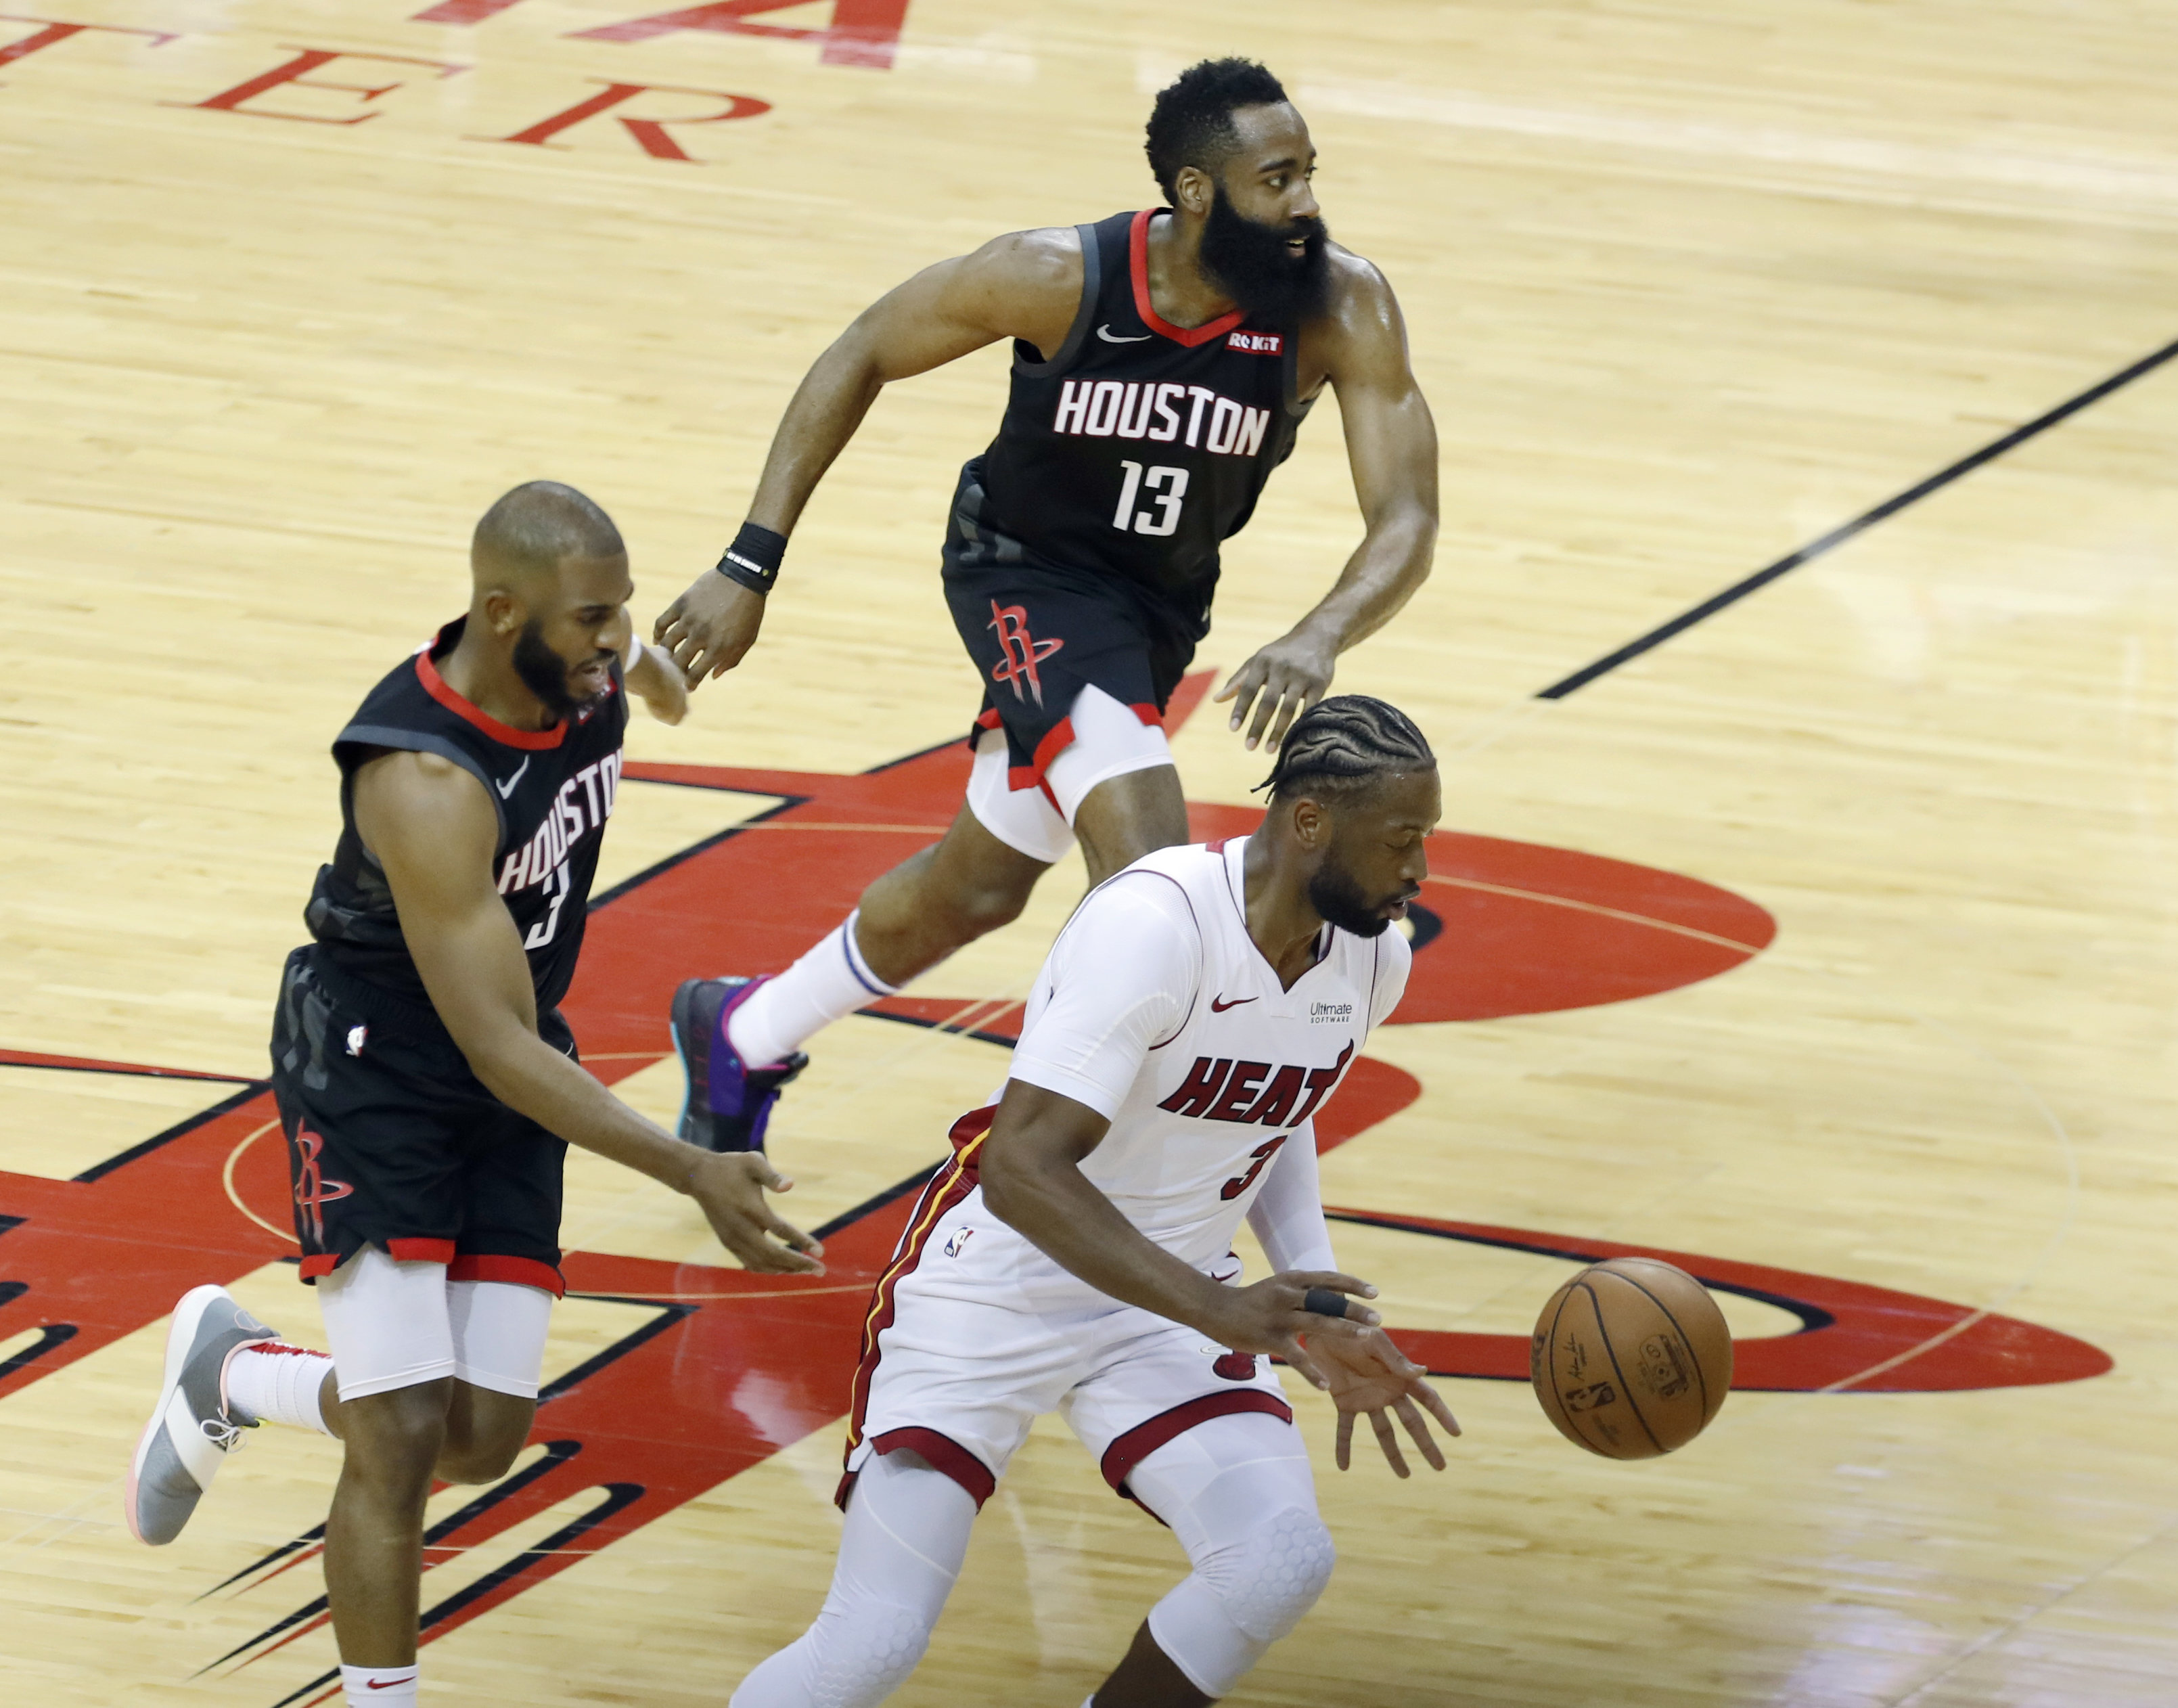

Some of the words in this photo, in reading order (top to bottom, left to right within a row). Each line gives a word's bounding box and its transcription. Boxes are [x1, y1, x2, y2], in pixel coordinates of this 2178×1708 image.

[1053, 380, 1271, 457] HOUSTON
[1112, 459, 1189, 537] 13
[523, 859, 570, 950] 3
[1311, 1002, 1352, 1016] Ultimate
[1311, 1016, 1349, 1024] SOFTWARE
[1156, 1038, 1354, 1127] HEAT
[1220, 1135, 1288, 1200] 3
